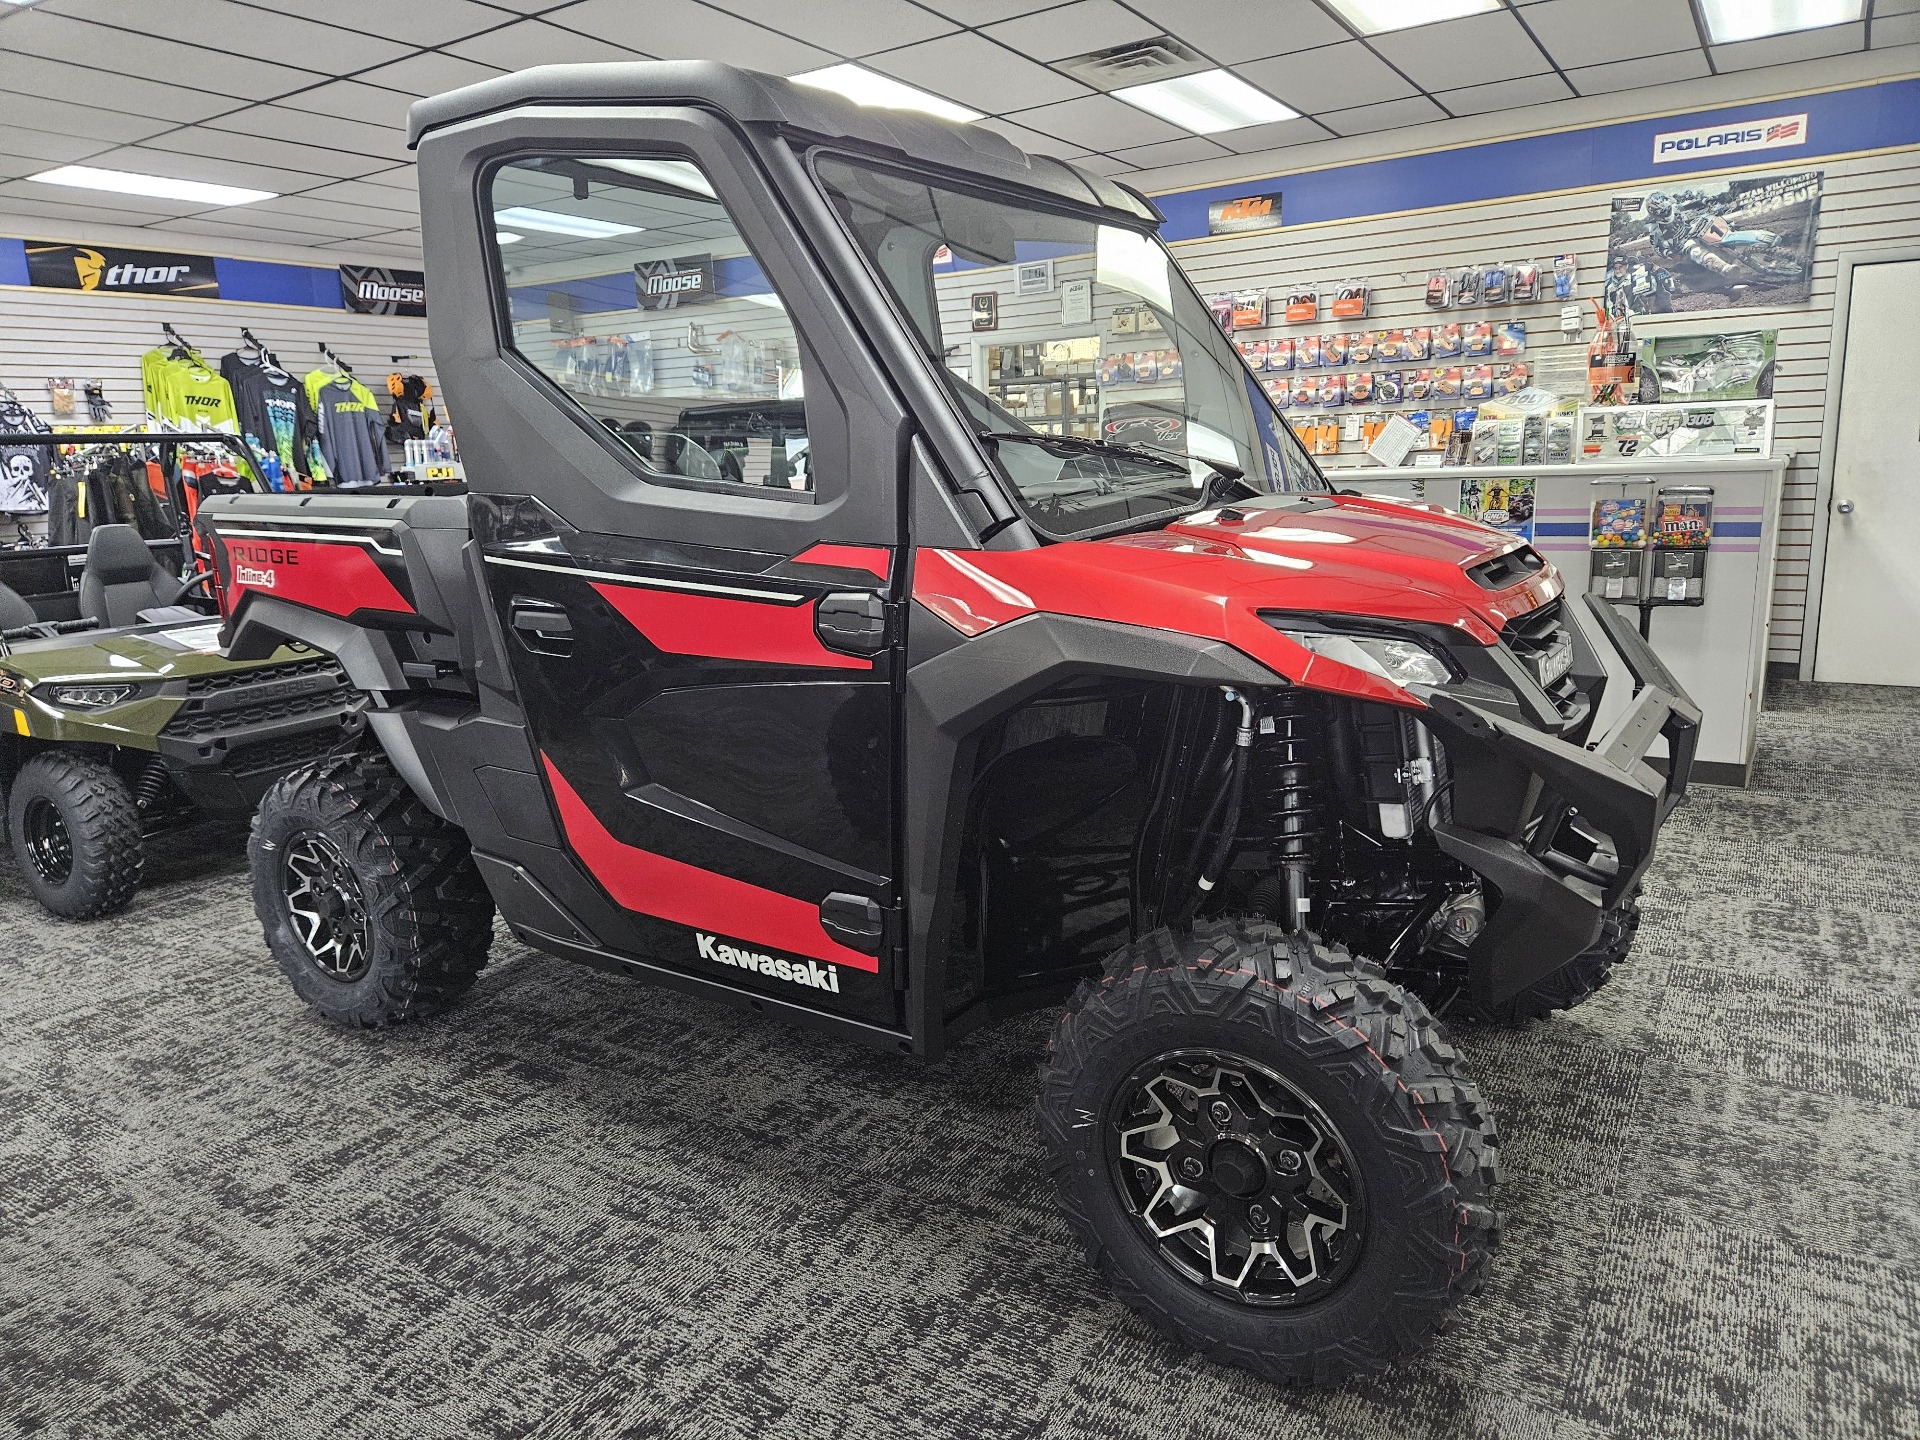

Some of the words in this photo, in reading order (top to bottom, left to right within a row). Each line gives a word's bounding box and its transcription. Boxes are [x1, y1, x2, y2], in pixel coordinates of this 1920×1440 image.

[1660, 128, 1763, 154] POLARIS
[1221, 196, 1273, 221] KTM
[105, 263, 190, 286] thor
[647, 274, 702, 295] Moose
[358, 281, 424, 303] Moose
[184, 395, 222, 408] THOR
[264, 399, 296, 410] THOR
[334, 401, 365, 413] THOR
[1618, 440, 1639, 453] 72
[427, 467, 455, 478] PJ1
[233, 546, 299, 565] RIDGE
[695, 932, 840, 994] Kawasaki
